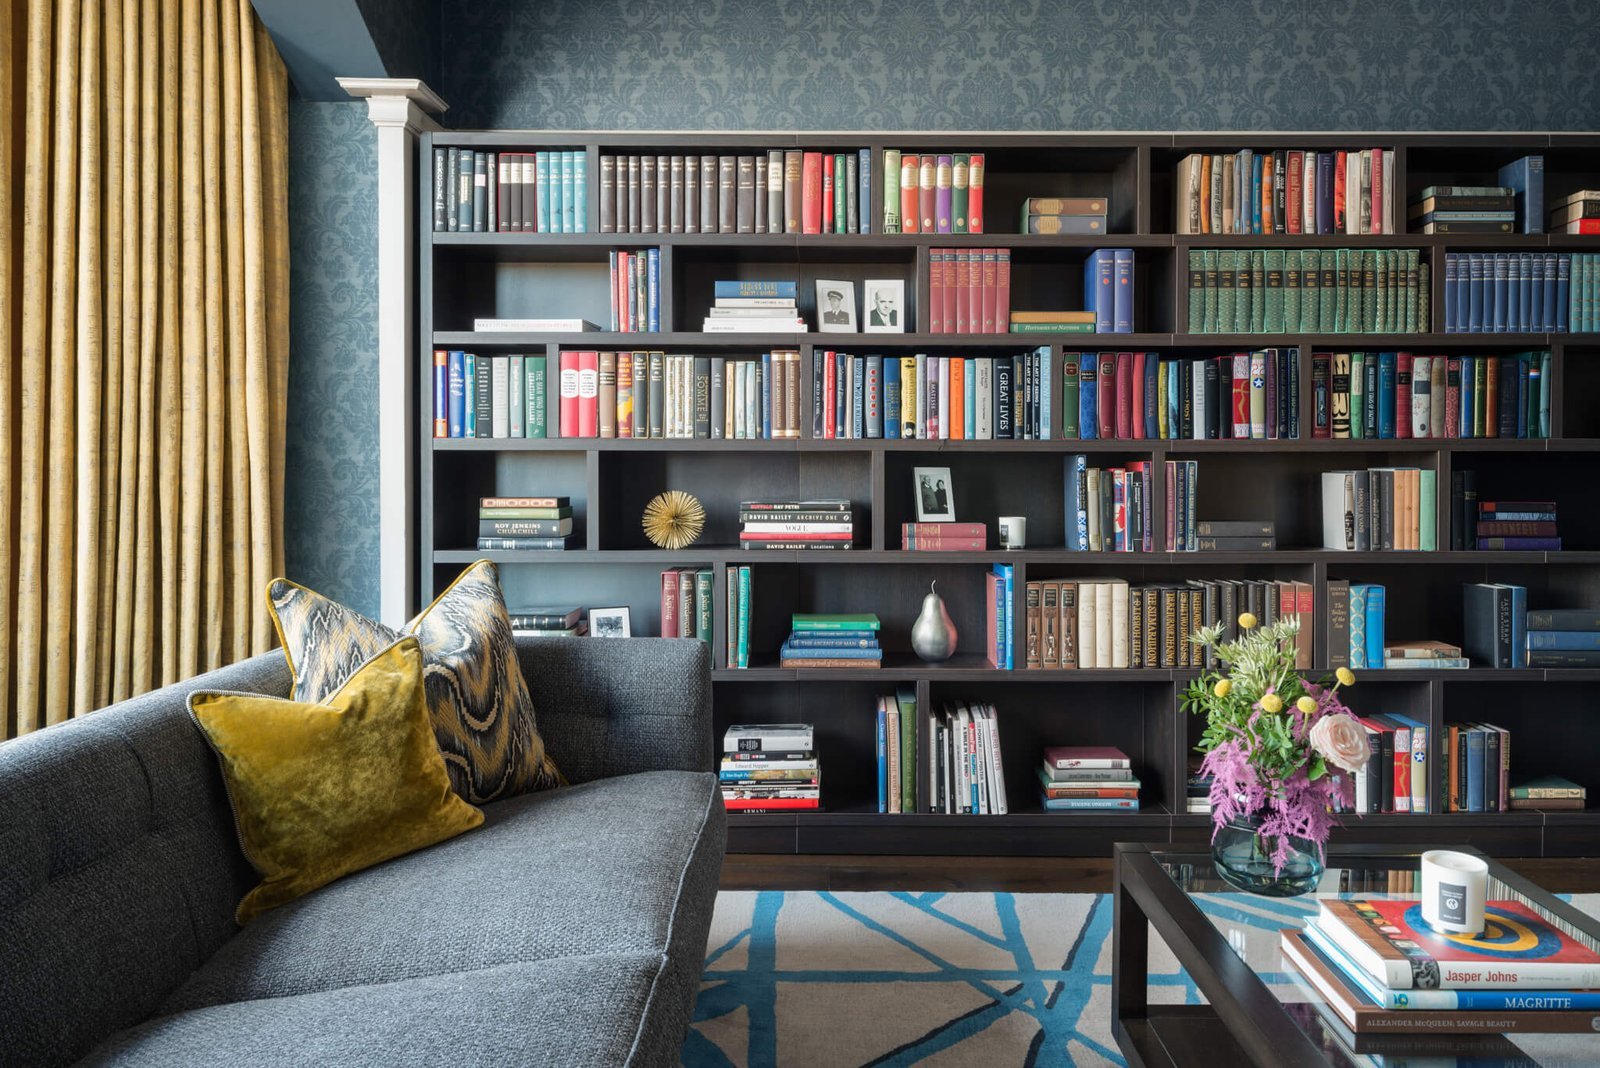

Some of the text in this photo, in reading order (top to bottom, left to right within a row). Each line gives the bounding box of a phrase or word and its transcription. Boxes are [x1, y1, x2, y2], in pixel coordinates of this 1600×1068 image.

[436, 155, 444, 200] DRACULA
[1291, 158, 1300, 219] Crime and Punishment
[697, 375, 705, 412] SOMME
[1000, 372, 1009, 430] GREAT LIVES
[665, 594, 675, 620] Kipling
[685, 594, 693, 637] Wordsworth
[700, 594, 710, 630] John Keats
[1180, 613, 1188, 626] TWO
[1133, 606, 1142, 655] THE HOBBIT
[1147, 592, 1157, 662] THE SILMARILLION
[1166, 645, 1175, 662] KING
[991, 729, 1001, 771] HERB RITTS
[1445, 970, 1518, 984] Jasper Johns
[1504, 997, 1572, 1009] MAGRITTE
[1456, 1020, 1484, 1028] SAVAGE
[1486, 1020, 1517, 1028] BEAUTY
